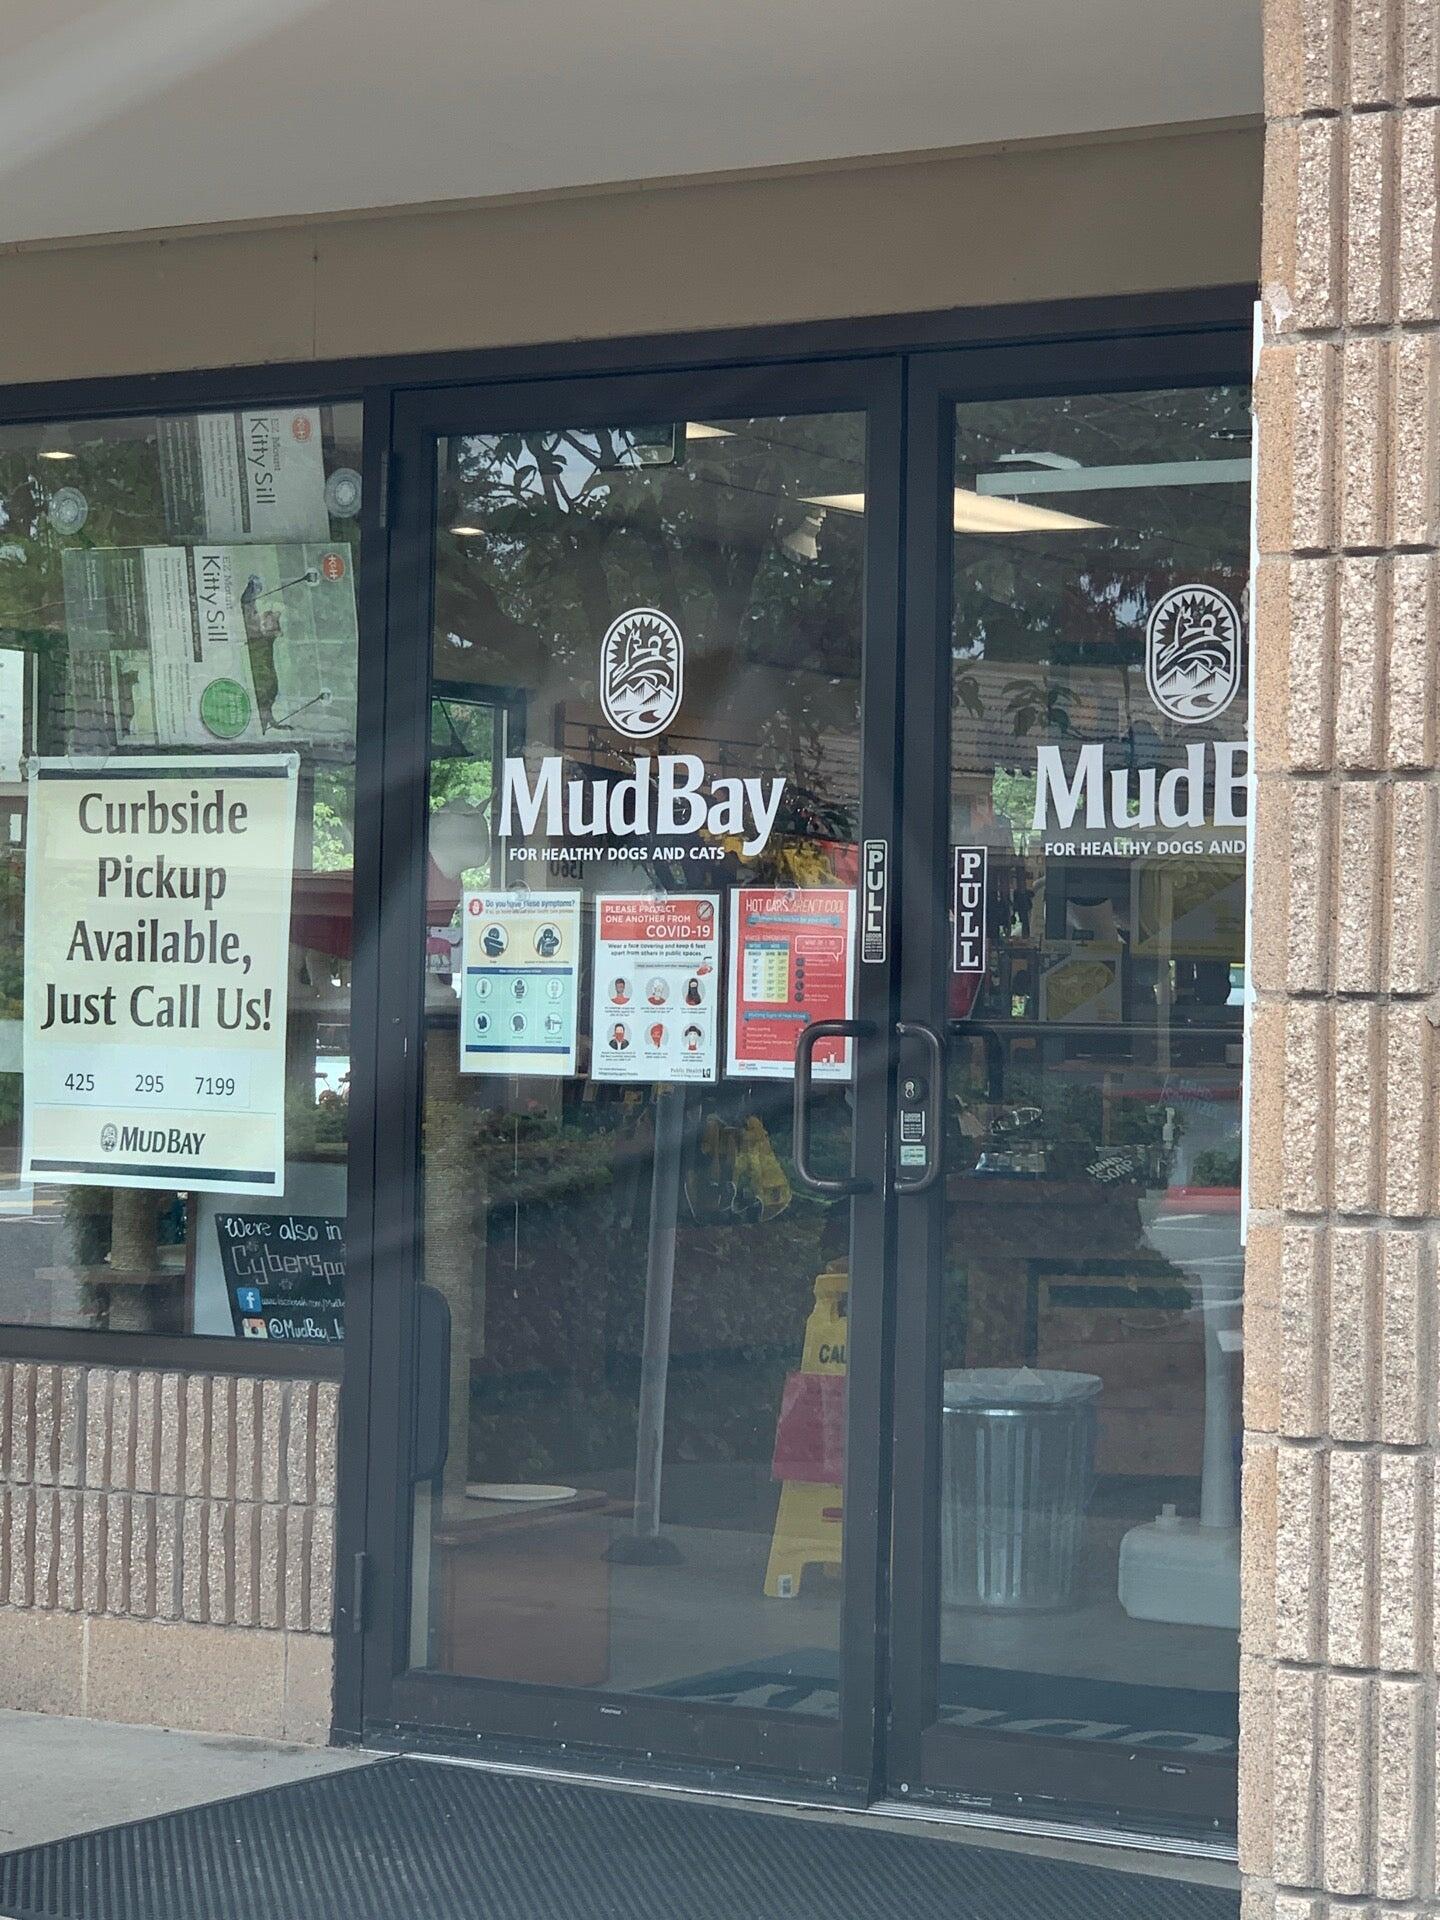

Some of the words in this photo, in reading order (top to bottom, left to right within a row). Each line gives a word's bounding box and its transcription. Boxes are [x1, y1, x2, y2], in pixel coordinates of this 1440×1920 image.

[248, 417, 270, 468] Kitty
[254, 472, 276, 504] Sill
[200, 555, 222, 606] Kitty
[206, 610, 228, 642] Sill
[78, 789, 249, 835] Curbside
[509, 848, 538, 861] FOR
[541, 847, 604, 861] HEALTHY
[608, 847, 648, 861] DOGS
[652, 847, 685, 860] AND
[689, 847, 725, 860] CATS
[1044, 842, 1076, 857] FOR
[1080, 841, 1151, 857] HEALTHY
[1157, 840, 1204, 856] DOGS
[1208, 839, 1247, 855] AND
[97, 854, 228, 911] Pickup
[867, 850, 884, 932] PULL
[605, 905, 637, 913] PLEASE
[605, 915, 623, 923] ONE
[626, 915, 665, 923] ANOTHER
[667, 914, 691, 923] FROM
[745, 899, 764, 912] HOT
[766, 899, 789, 912] CARS
[824, 899, 846, 913] COOL
[959, 852, 982, 967] PULL
[66, 918, 252, 975] Available,
[646, 925, 711, 938] COVID-19
[40, 983, 117, 1030] Just
[129, 983, 201, 1029] Call
[216, 986, 272, 1031] Us!
[64, 1072, 95, 1092] 425
[135, 1074, 164, 1093] 295
[195, 1076, 236, 1097] 7199
[279, 1217, 318, 1241] also
[325, 1220, 343, 1241] in
